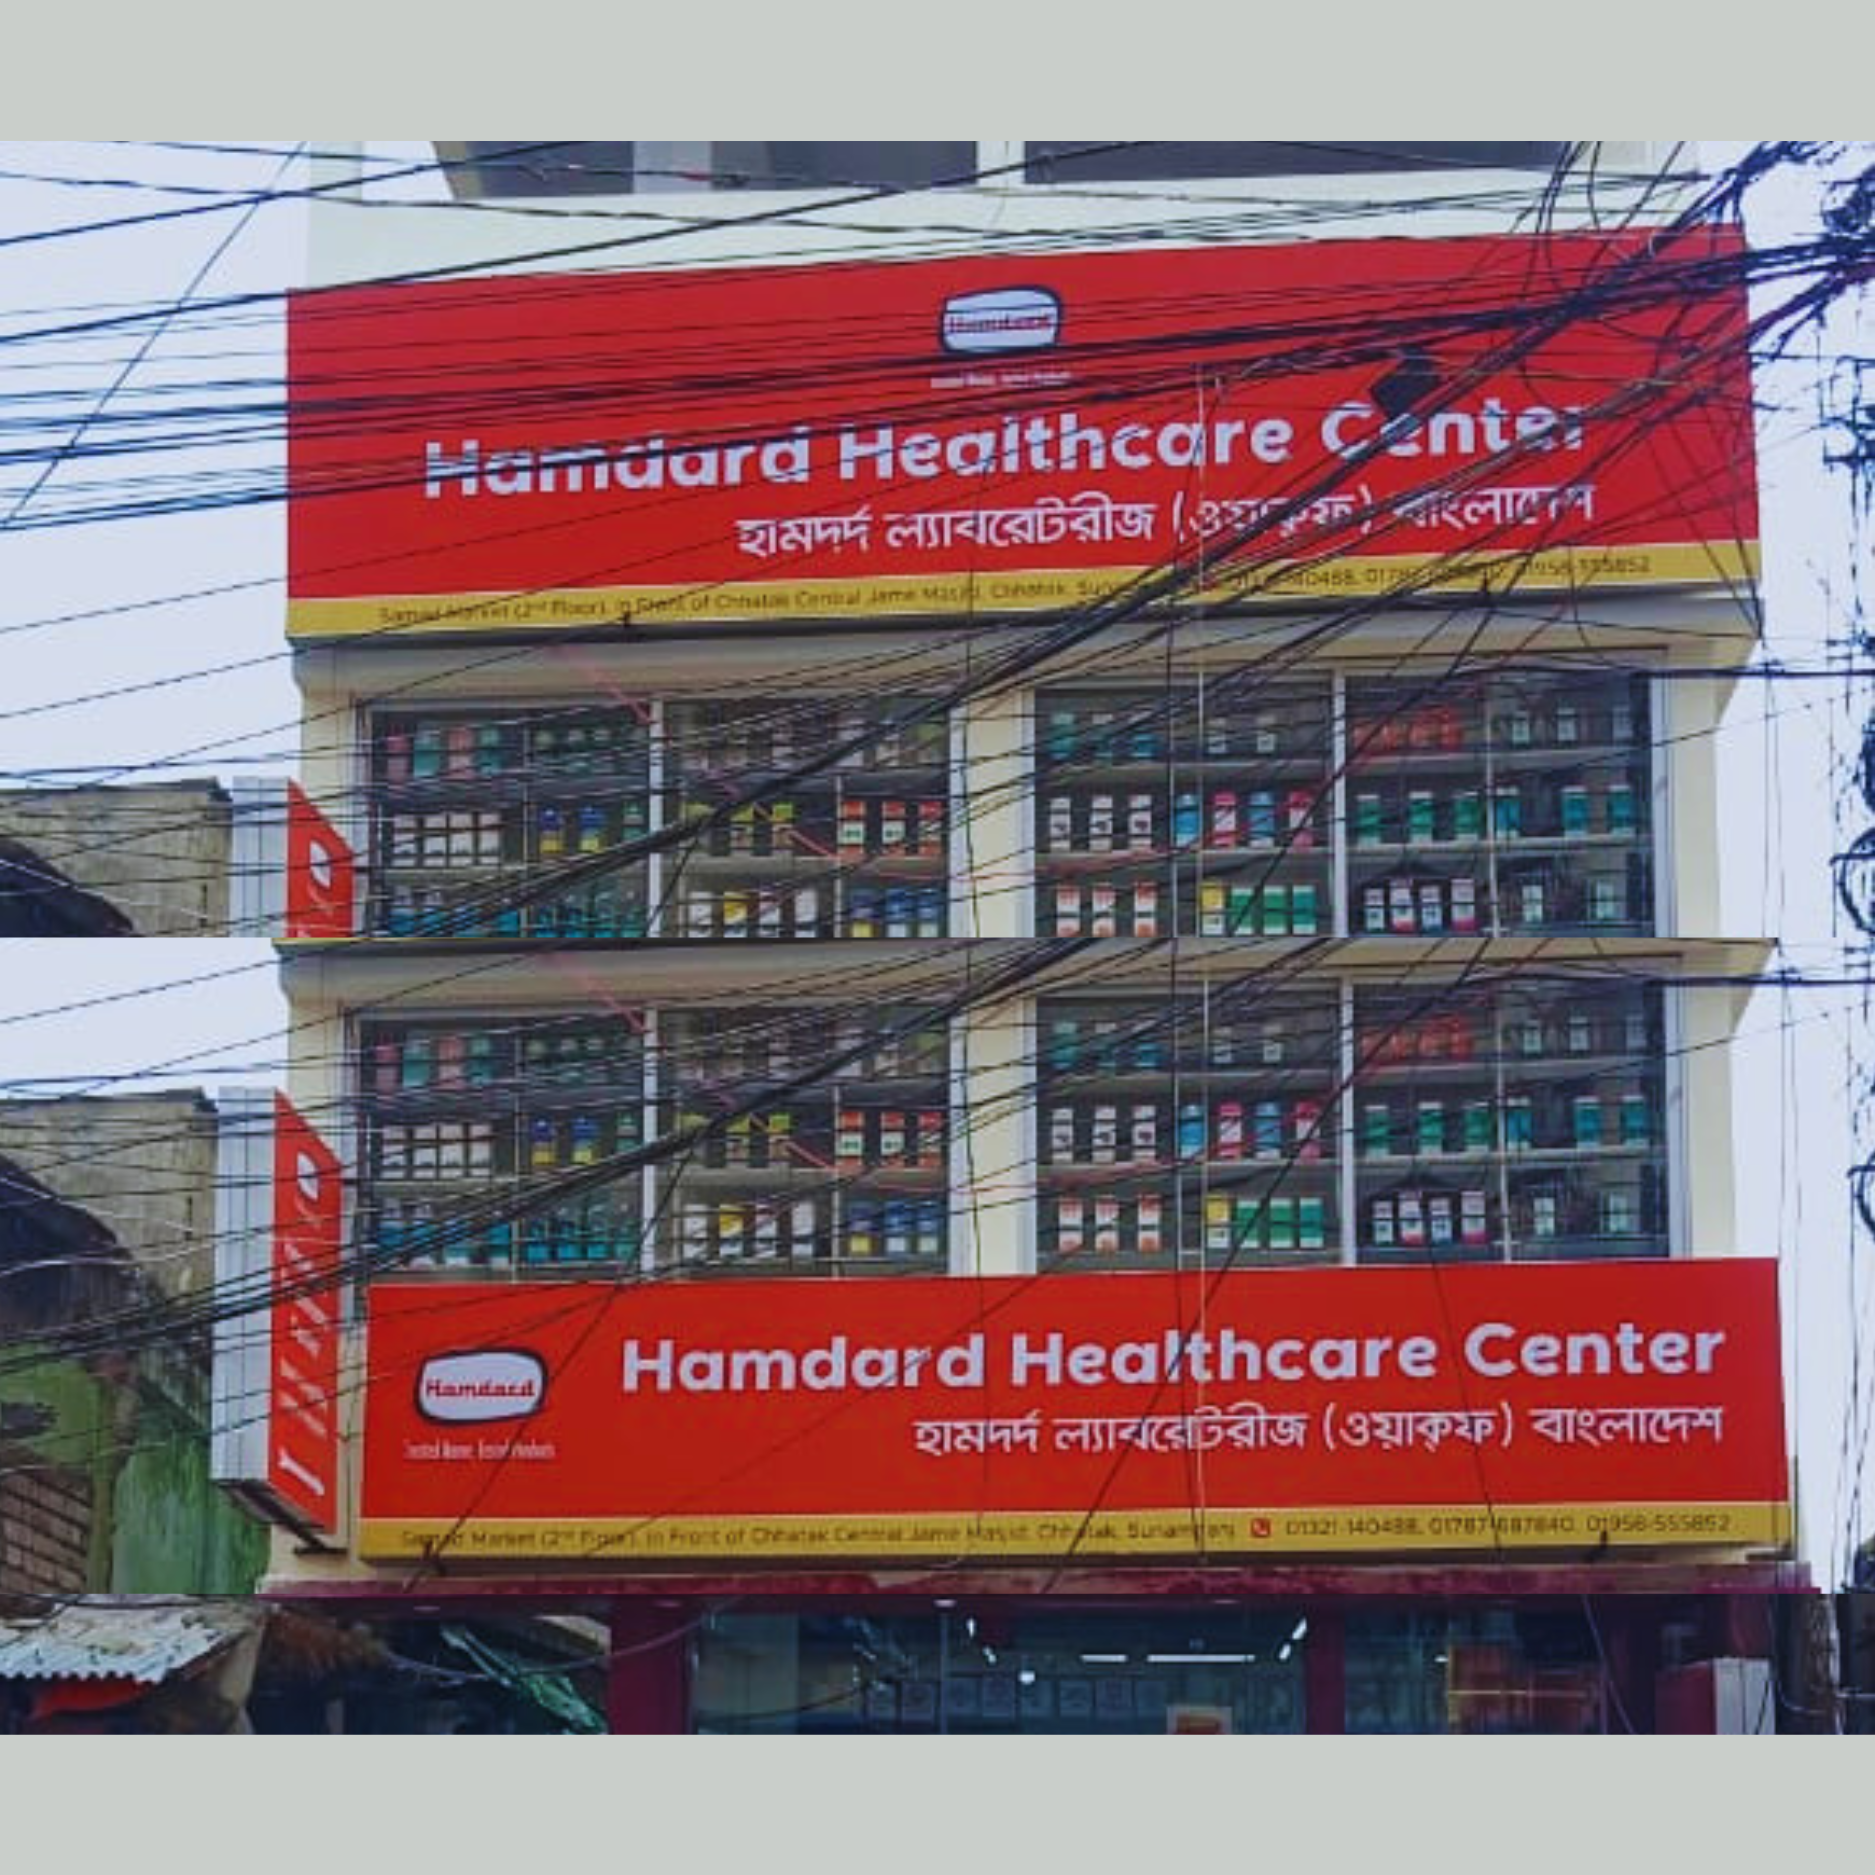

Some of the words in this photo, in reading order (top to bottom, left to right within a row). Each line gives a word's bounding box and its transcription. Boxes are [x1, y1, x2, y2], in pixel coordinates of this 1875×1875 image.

[425, 425, 811, 498] Hamdard
[838, 412, 1294, 480] Healthcare
[735, 503, 873, 558] হামদর্দ
[623, 1335, 985, 1393] Hamdard
[1011, 1329, 1438, 1386] Healthcare
[1464, 1322, 1726, 1377] Center
[426, 1378, 535, 1398] Hamdard
[914, 1409, 1042, 1456] হামদর্দ
[1052, 1400, 1310, 1453] ল্যাবরেটরীজ
[1529, 1404, 1724, 1447] বাংলাদেশ
[725, 1527, 745, 1545] of
